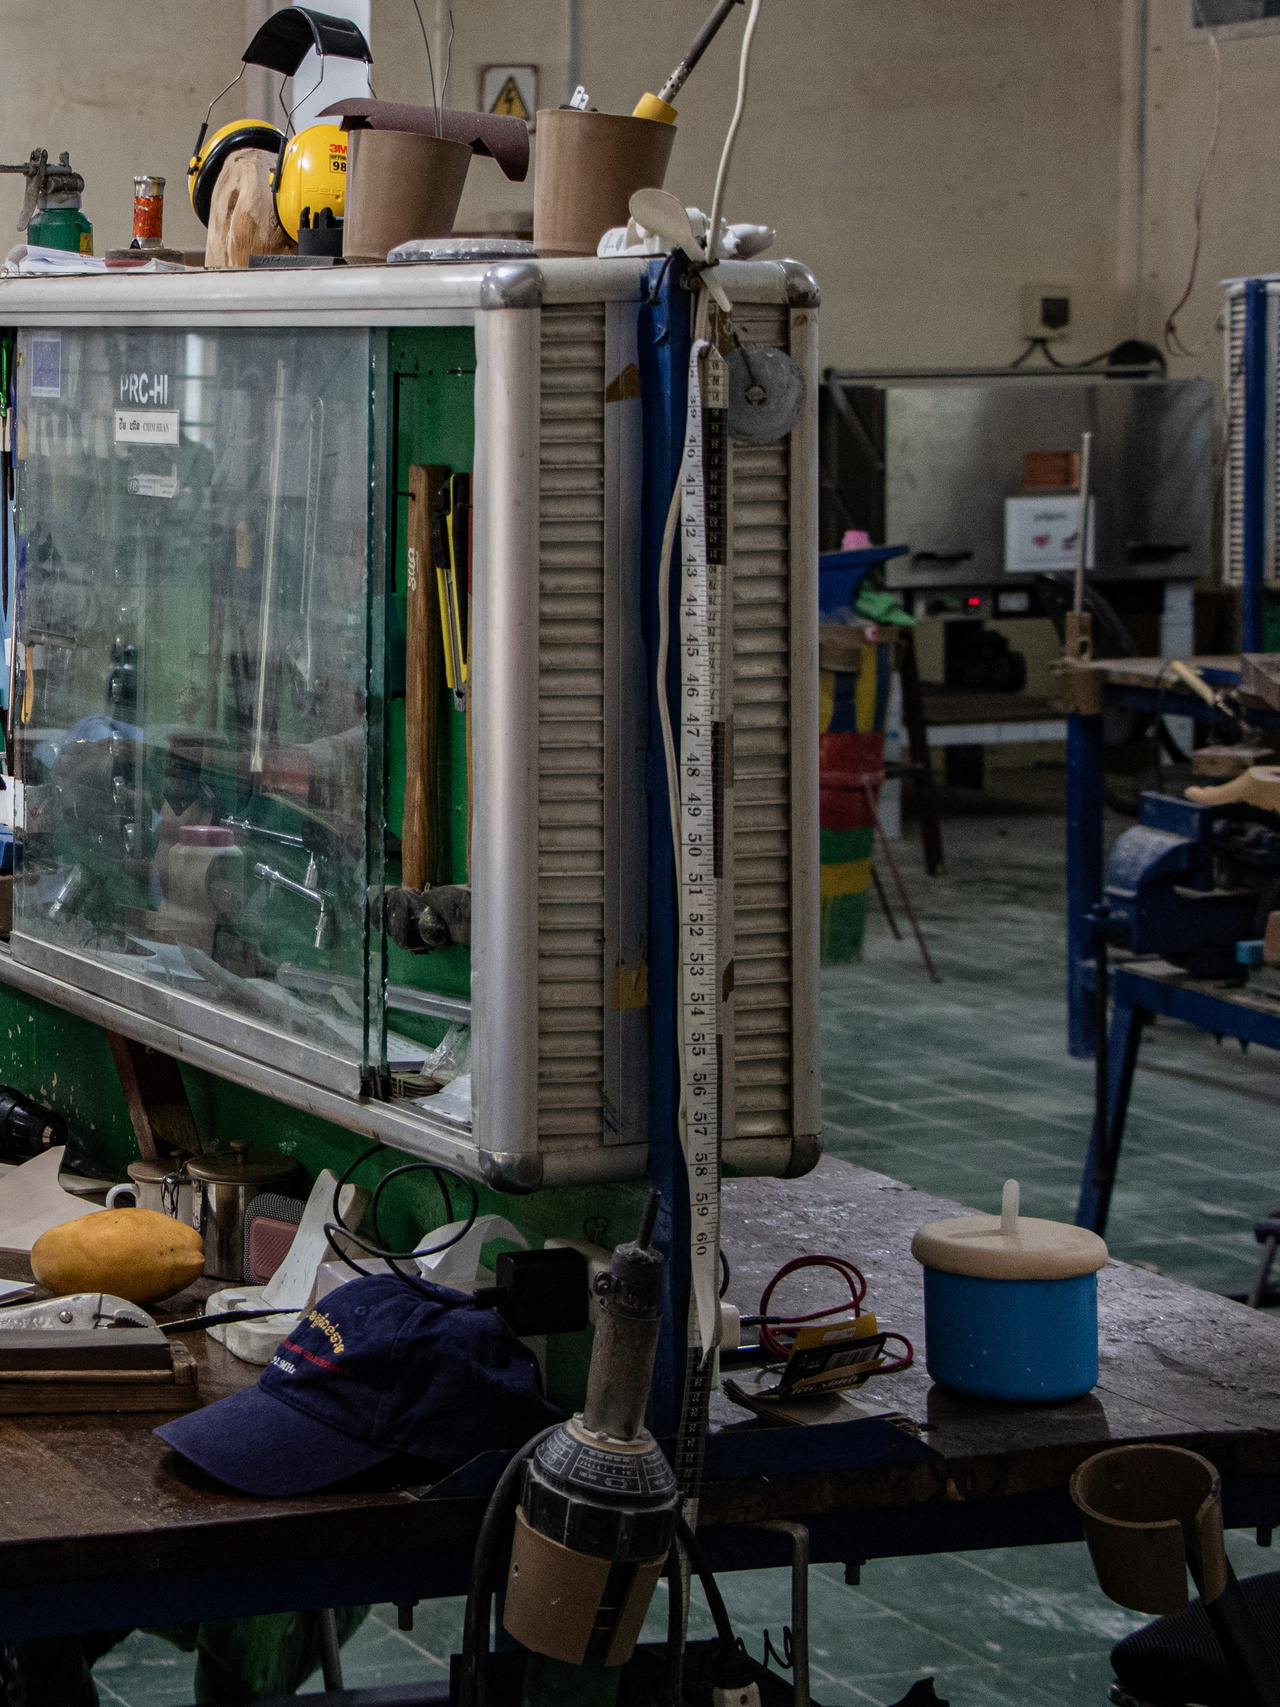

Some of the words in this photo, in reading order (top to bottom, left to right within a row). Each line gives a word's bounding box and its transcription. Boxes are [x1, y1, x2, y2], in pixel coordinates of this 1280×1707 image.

[332, 160, 347, 172] 98
[687, 434, 696, 458] 40
[686, 474, 696, 497] 41
[686, 514, 696, 538] 42
[686, 554, 697, 578] 43
[686, 594, 698, 618] 44
[687, 634, 698, 657] 45
[687, 673, 699, 697] 46
[687, 713, 700, 737] 47
[687, 753, 700, 777] 48
[688, 793, 701, 817] 49
[688, 832, 702, 857] 50
[689, 873, 703, 896] 51
[689, 913, 704, 936] 52
[690, 953, 704, 976] 53
[691, 992, 704, 1016] 54
[692, 1032, 706, 1056] 55
[693, 1073, 707, 1096] 56
[694, 1112, 707, 1136] 57
[695, 1153, 708, 1177] 58
[696, 1193, 708, 1217] 59
[696, 1232, 708, 1256] 60
